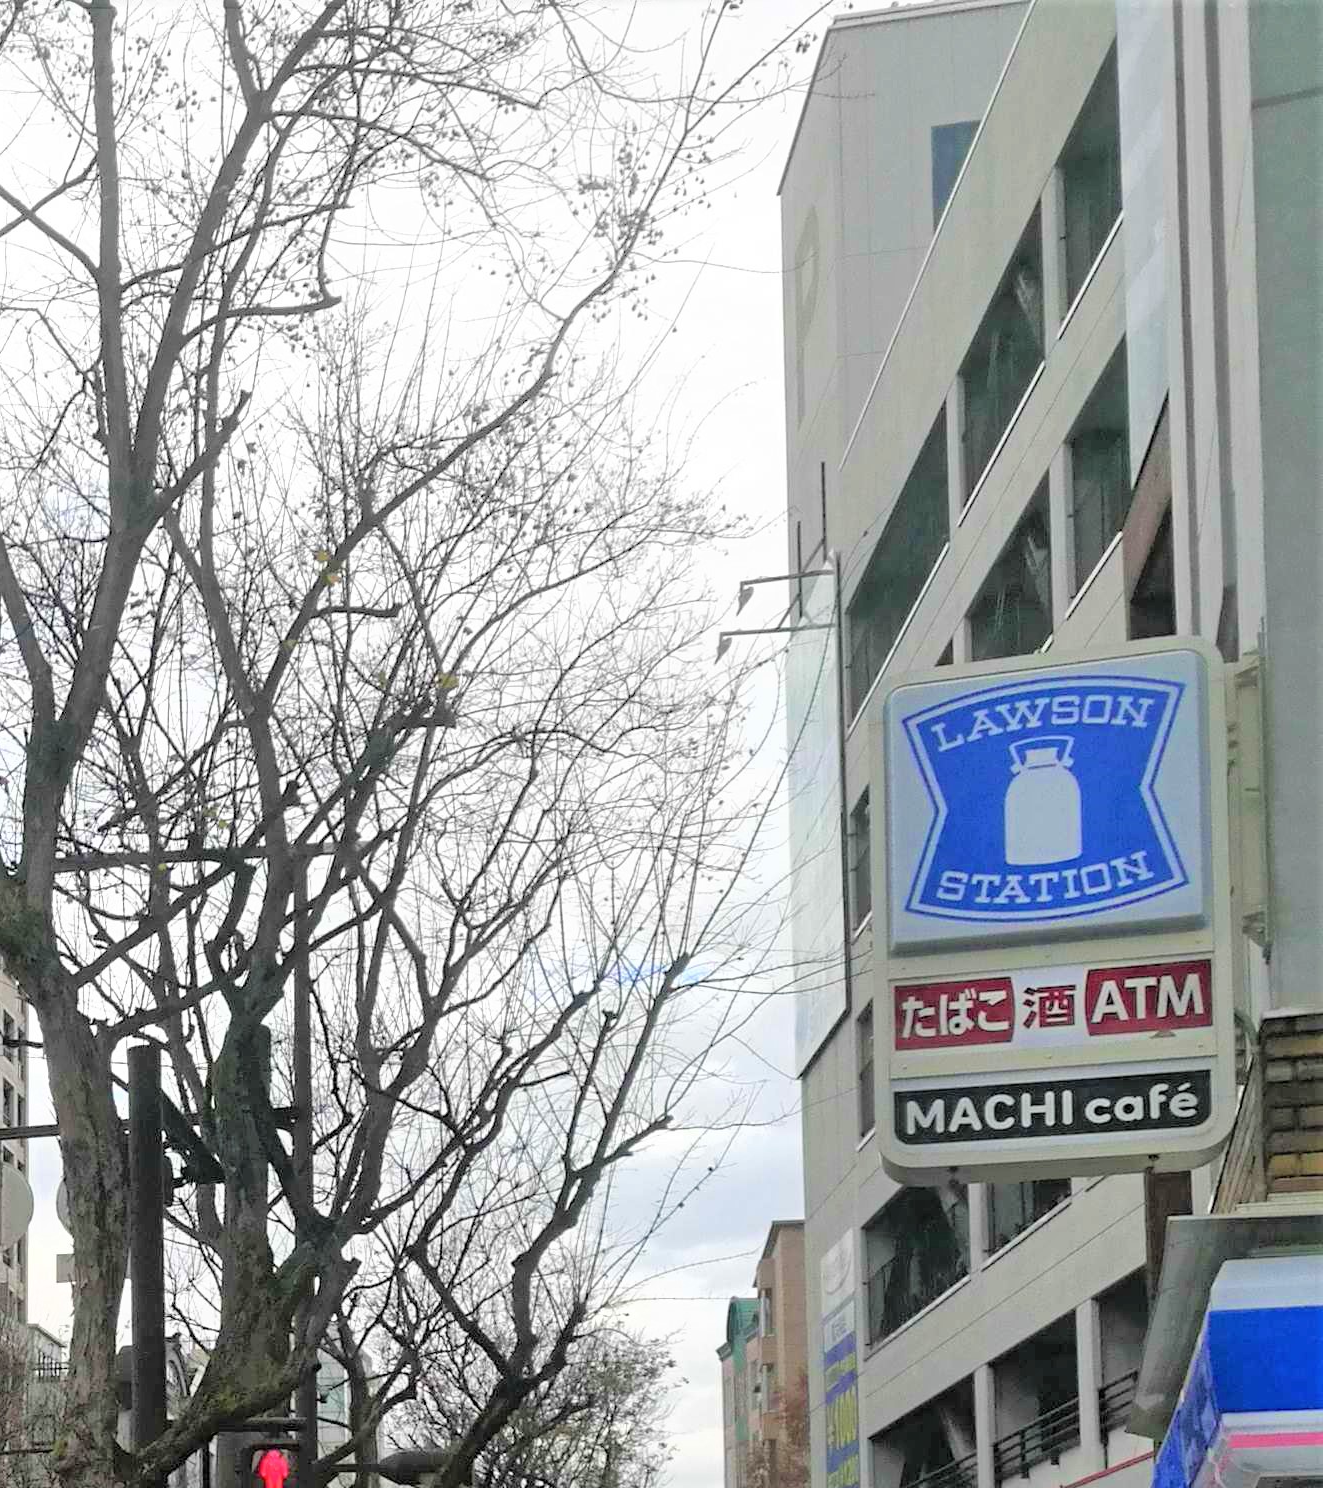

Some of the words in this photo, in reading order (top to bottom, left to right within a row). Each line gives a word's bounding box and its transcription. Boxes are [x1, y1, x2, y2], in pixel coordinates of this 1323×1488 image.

[932, 695, 1154, 752] LAWSON
[936, 850, 1155, 904] STATION
[901, 989, 1012, 1038] たばこ
[1022, 983, 1077, 1029] 酒
[1091, 972, 1205, 1025] ATM
[906, 1092, 1073, 1135] MACHI
[1085, 1083, 1198, 1123] café
